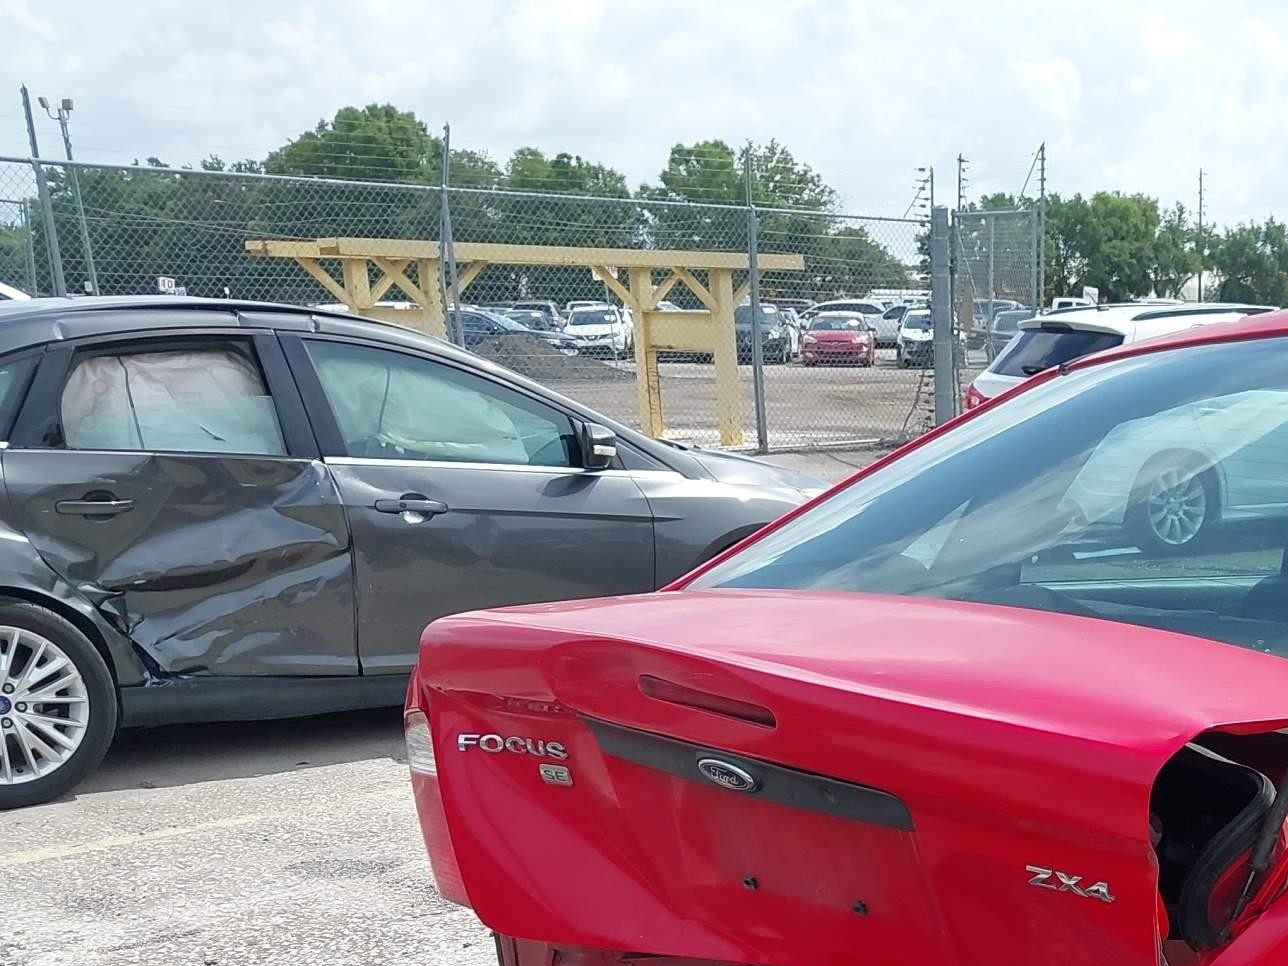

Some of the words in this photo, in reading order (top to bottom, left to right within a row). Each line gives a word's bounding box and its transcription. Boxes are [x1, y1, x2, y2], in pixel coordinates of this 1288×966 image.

[457, 734, 569, 761] FOCUS
[543, 769, 567, 782] SE
[1025, 864, 1116, 903] ZX4
